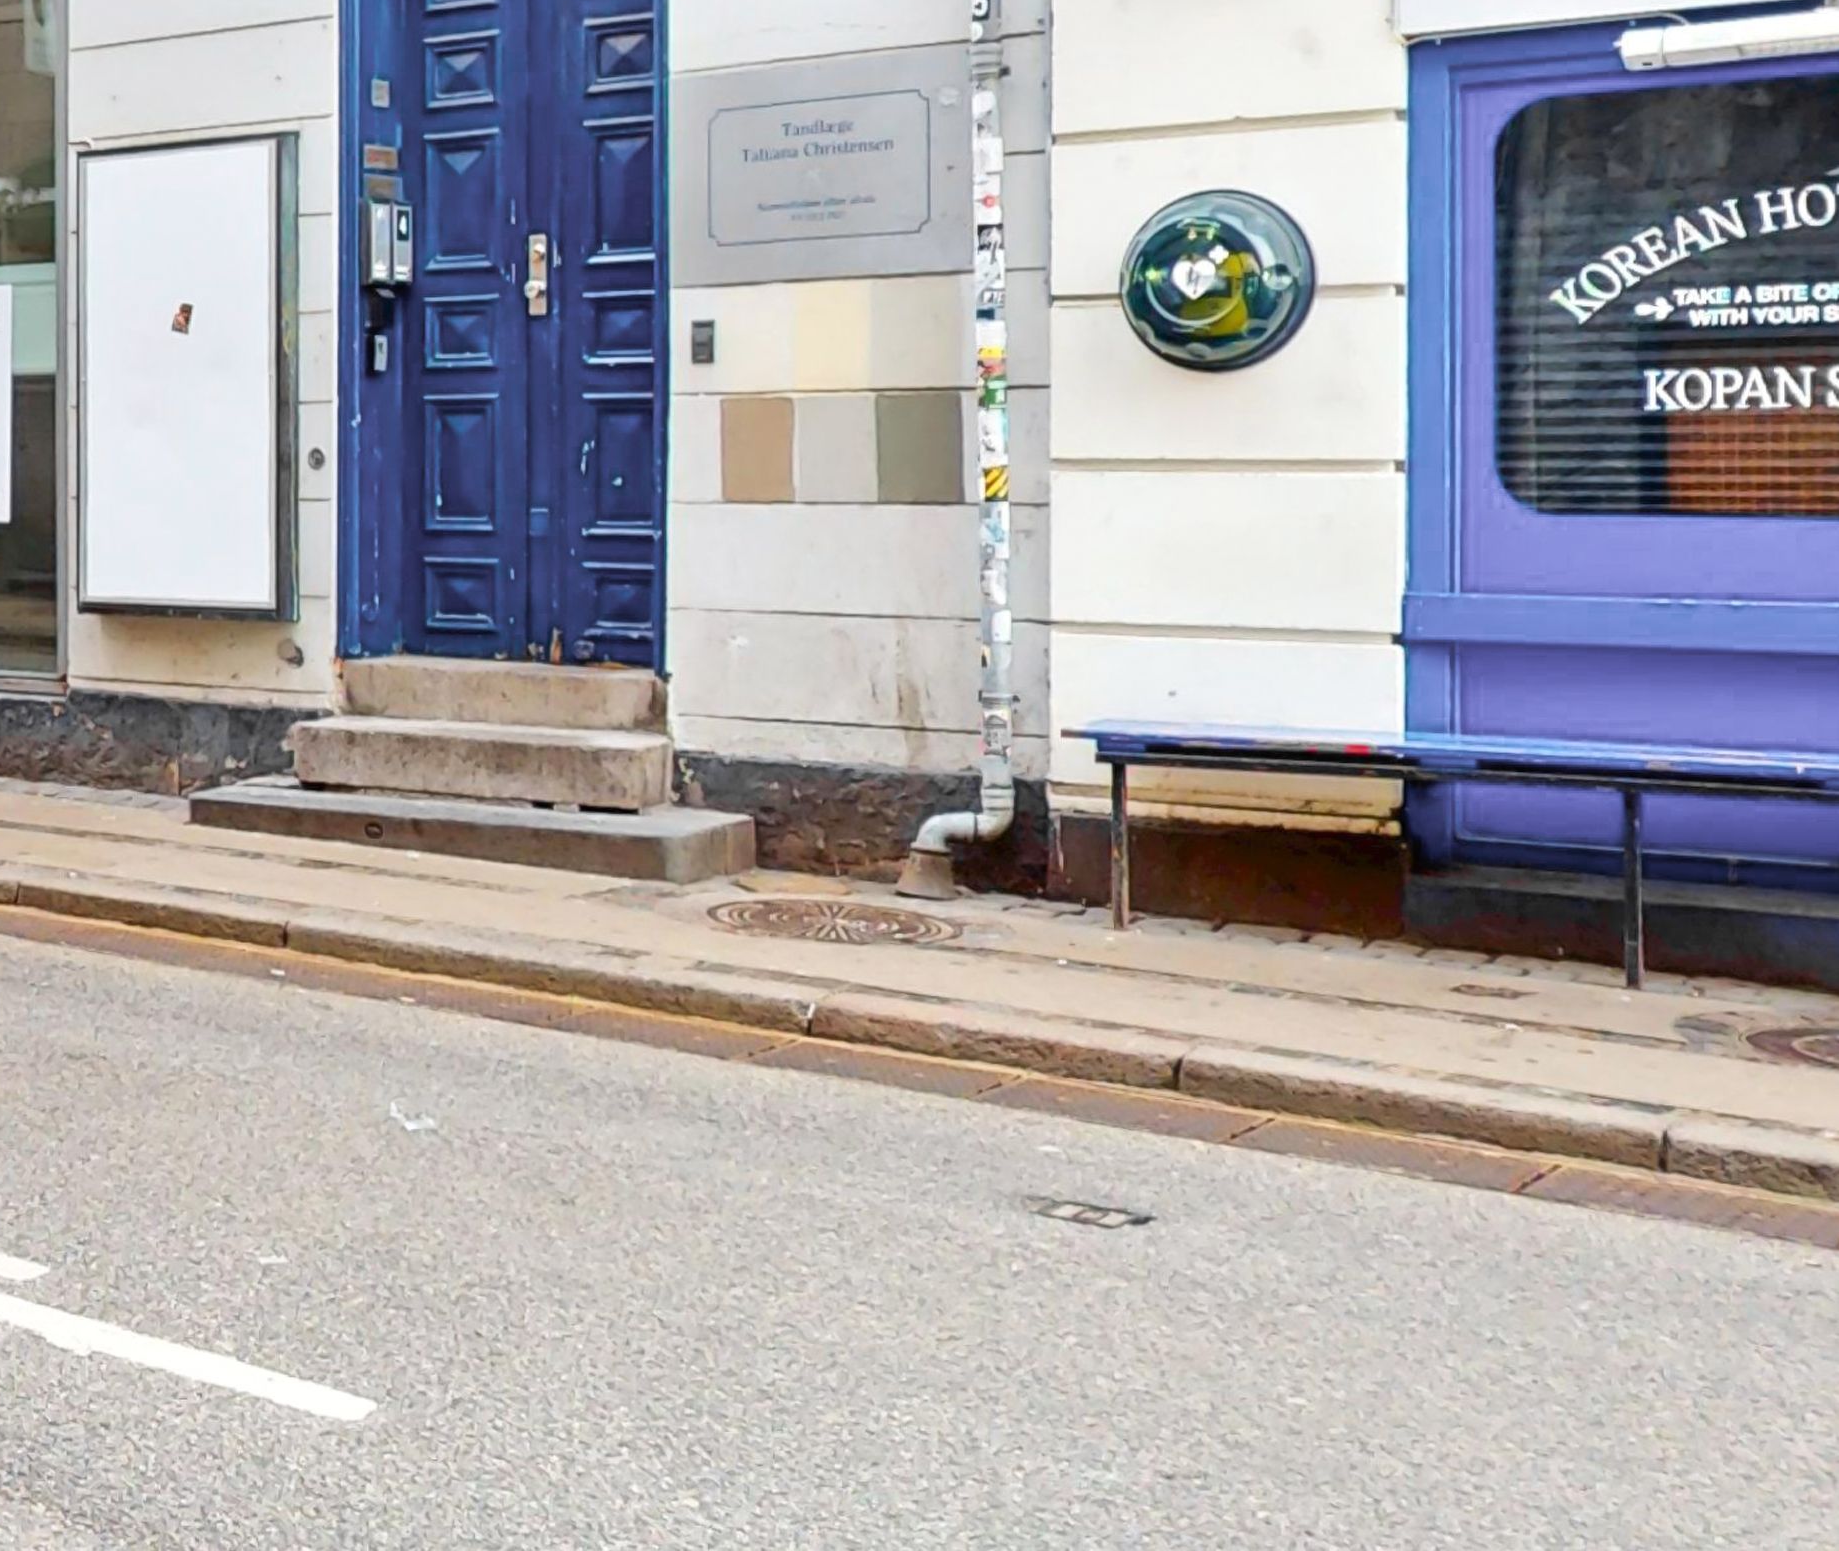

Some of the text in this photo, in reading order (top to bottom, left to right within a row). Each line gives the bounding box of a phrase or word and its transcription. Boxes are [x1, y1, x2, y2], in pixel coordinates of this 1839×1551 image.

[803, 138, 894, 158] Christensen
[1549, 184, 1839, 325] KOREAN HO
[1673, 287, 1731, 306] TAKE
[1734, 286, 1752, 304] A
[1756, 284, 1808, 303] BITE
[1689, 306, 1749, 327] WITH
[1753, 305, 1819, 325] YOUR
[1643, 366, 1817, 411] KOPAN
